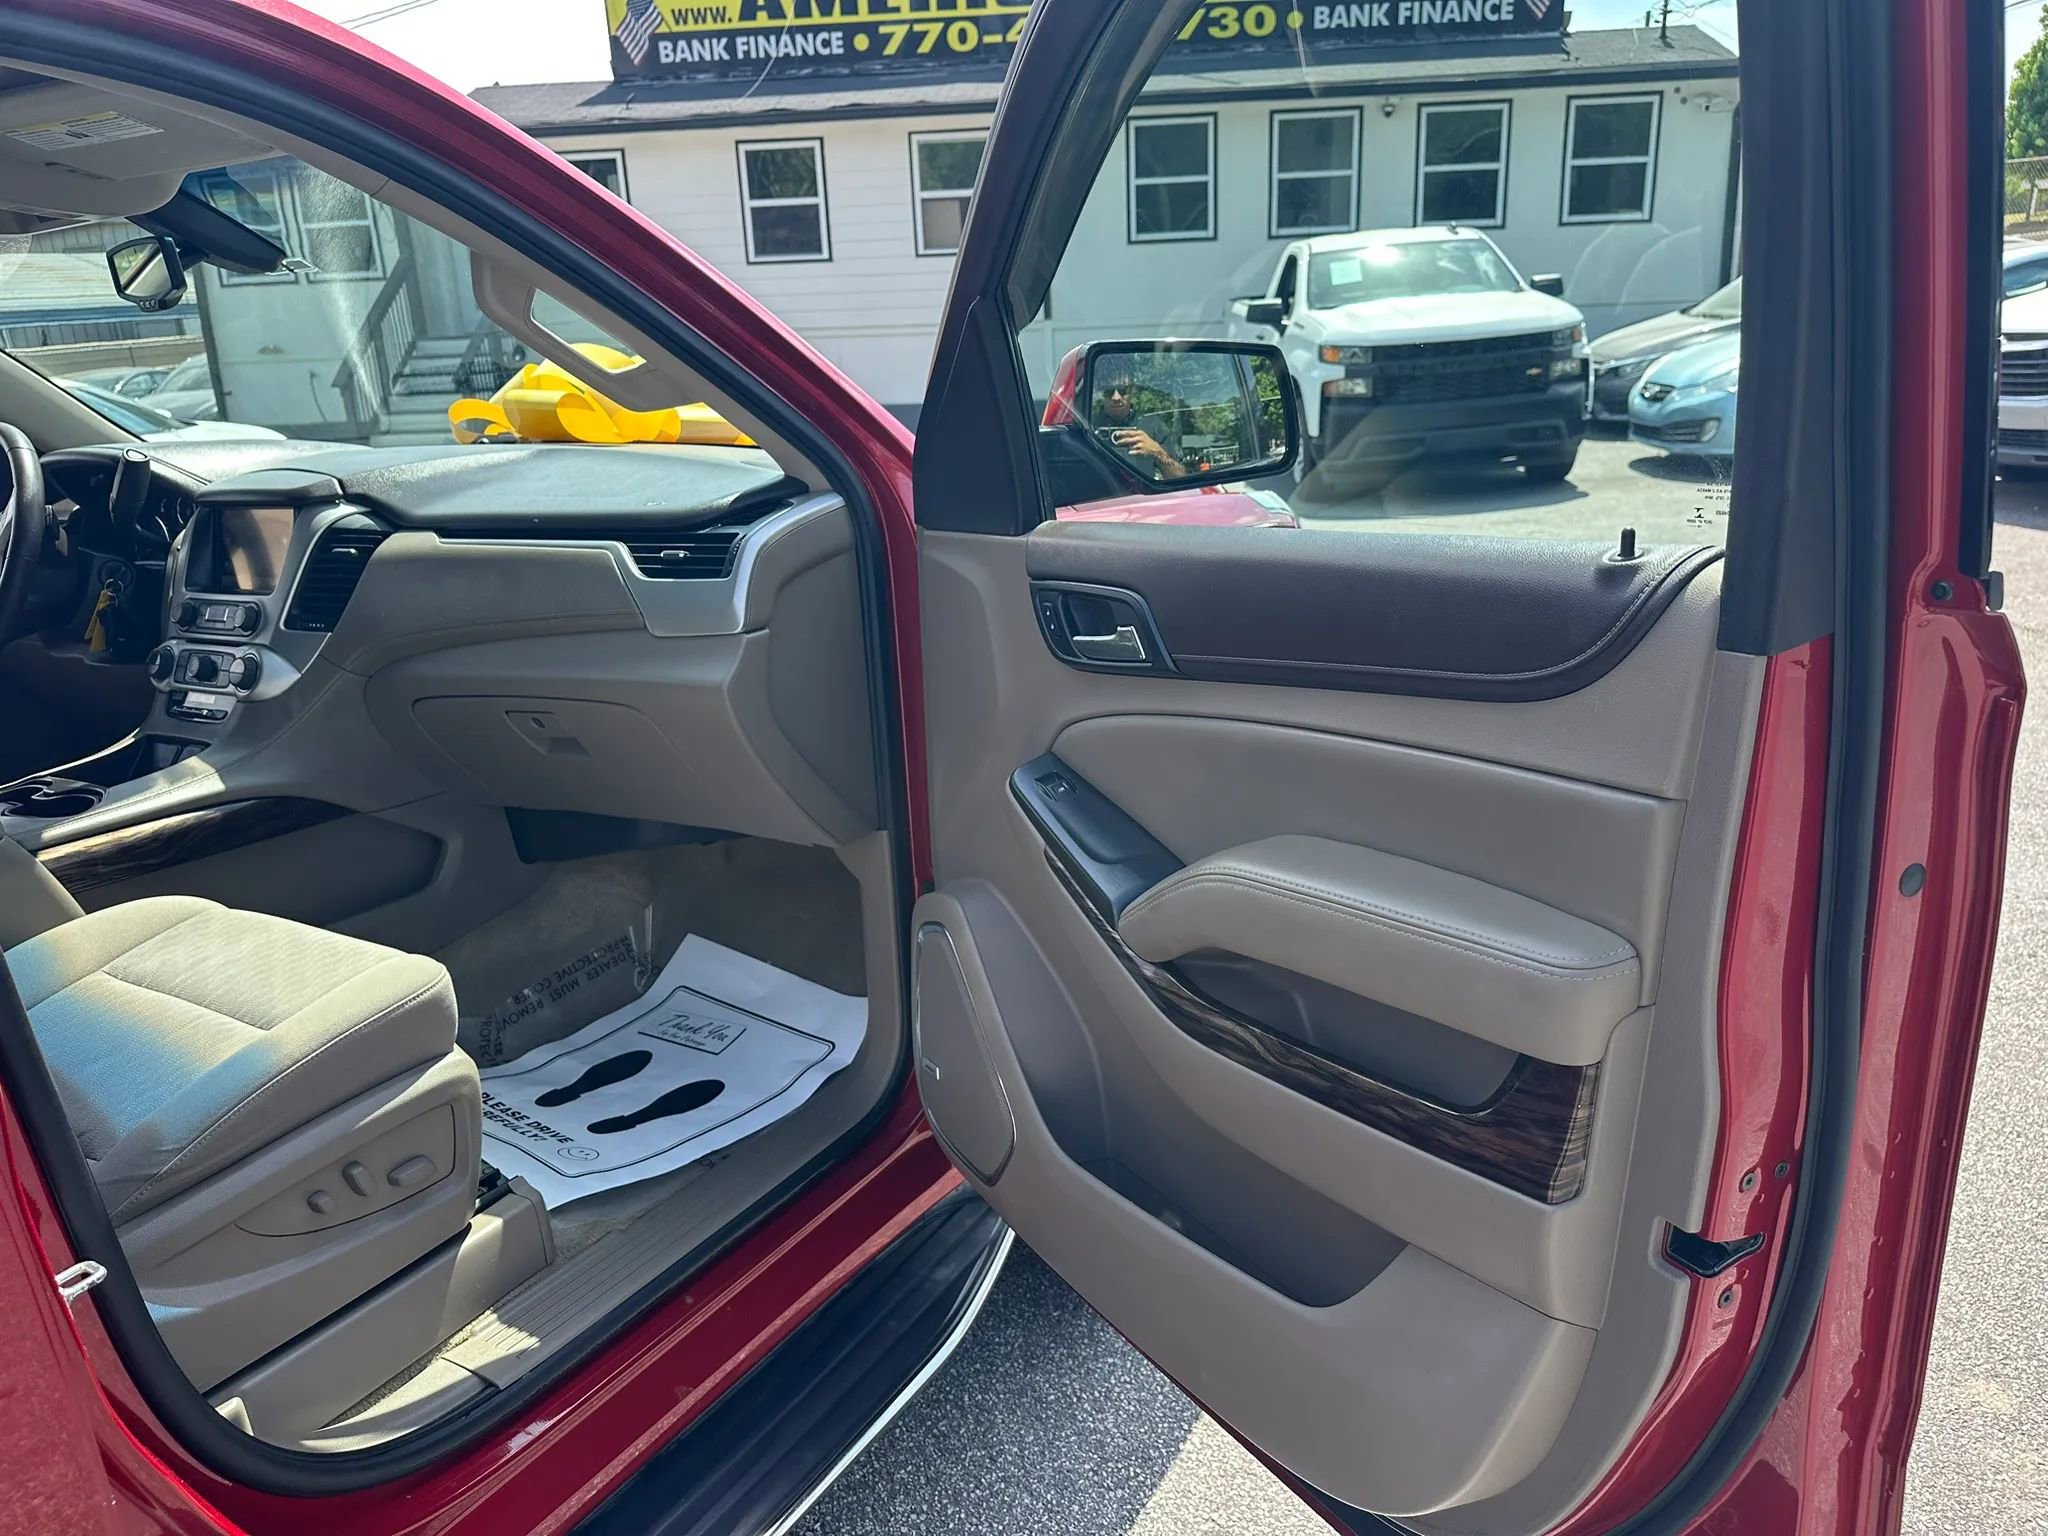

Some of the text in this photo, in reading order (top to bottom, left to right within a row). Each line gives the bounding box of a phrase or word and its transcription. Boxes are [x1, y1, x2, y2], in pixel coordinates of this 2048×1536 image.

[658, 37, 730, 64] BANK
[735, 31, 844, 60] FINANCE
[1313, 3, 1390, 30] BANK
[1398, 0, 1516, 25] FINANCE
[585, 951, 626, 981] DEALER
[548, 977, 580, 1003] MUST
[481, 1091, 575, 1144] PLEASE DRIVE
[482, 1108, 548, 1141] REFULLY!
